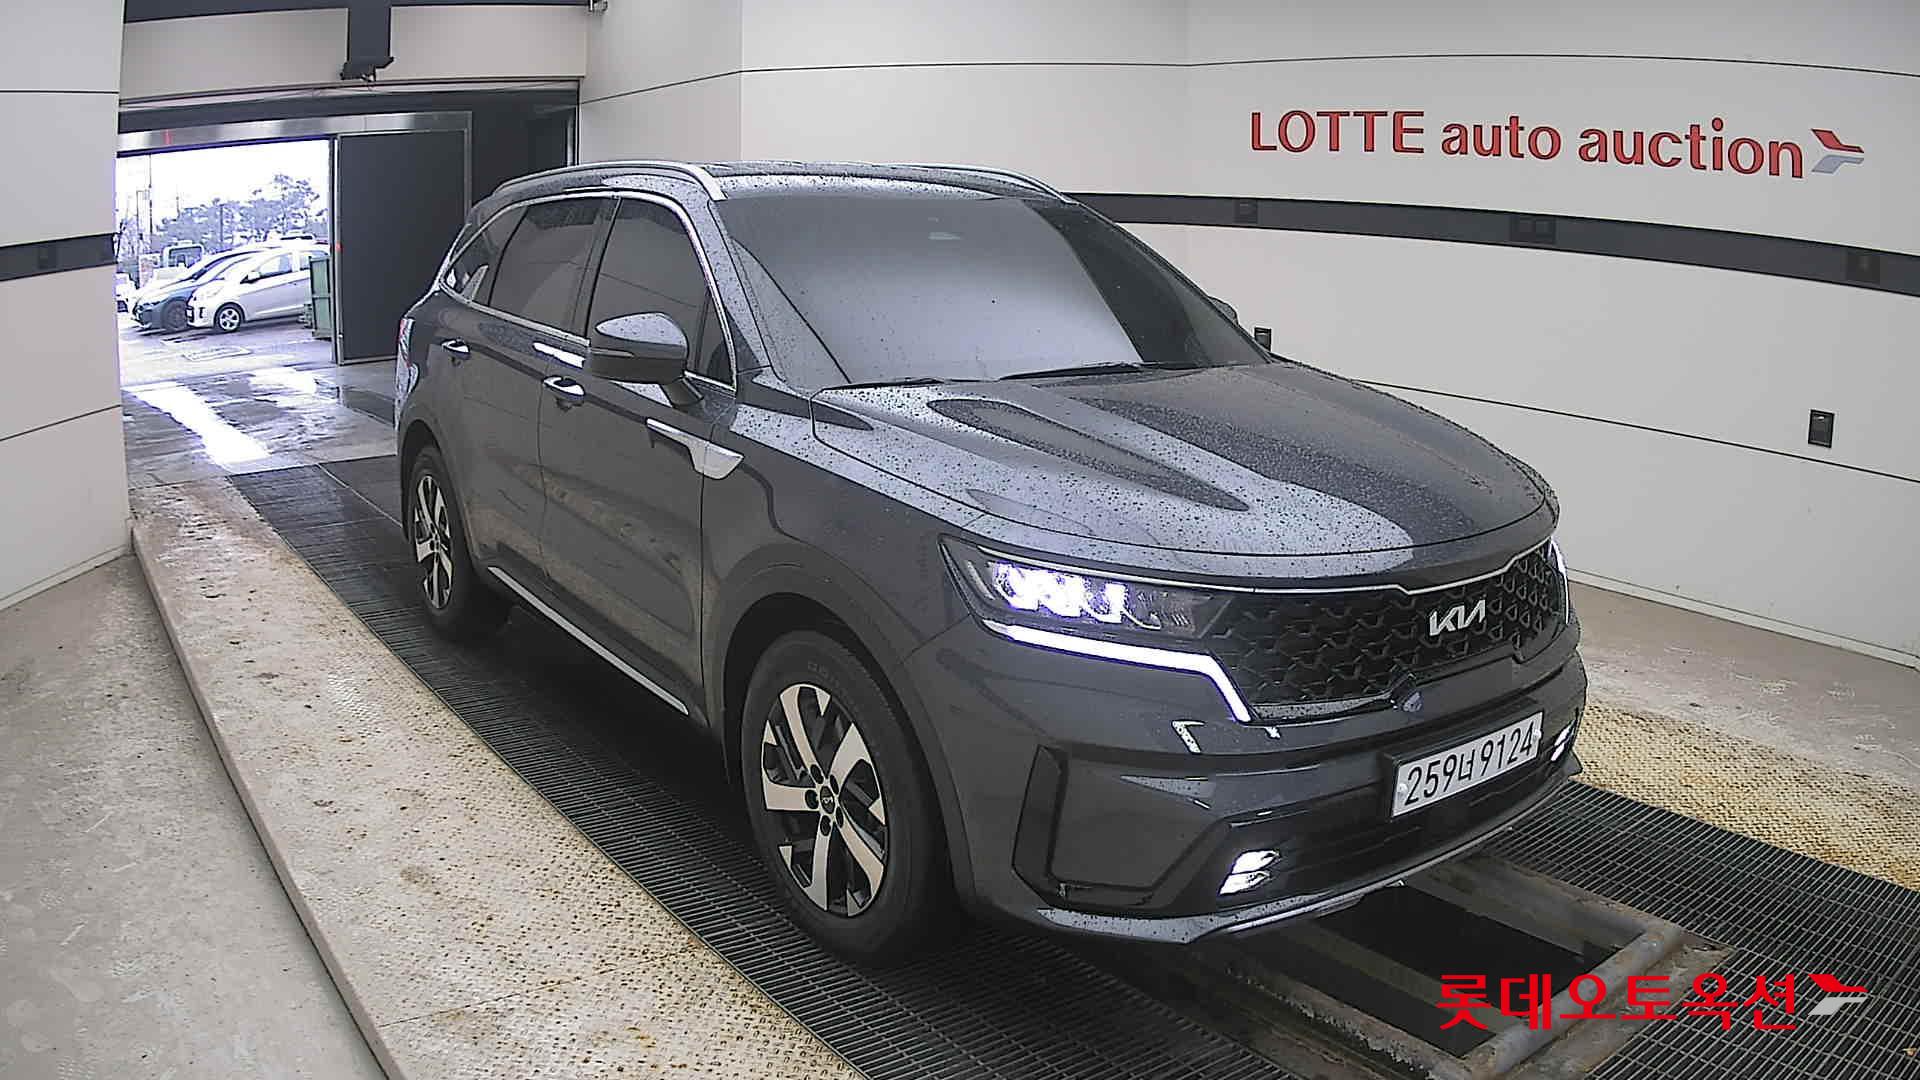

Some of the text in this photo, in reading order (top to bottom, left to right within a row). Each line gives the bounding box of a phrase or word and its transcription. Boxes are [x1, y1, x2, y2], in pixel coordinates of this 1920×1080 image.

[1250, 110, 1804, 179] LOTTE auto auction
[1428, 599, 1486, 637] KIA
